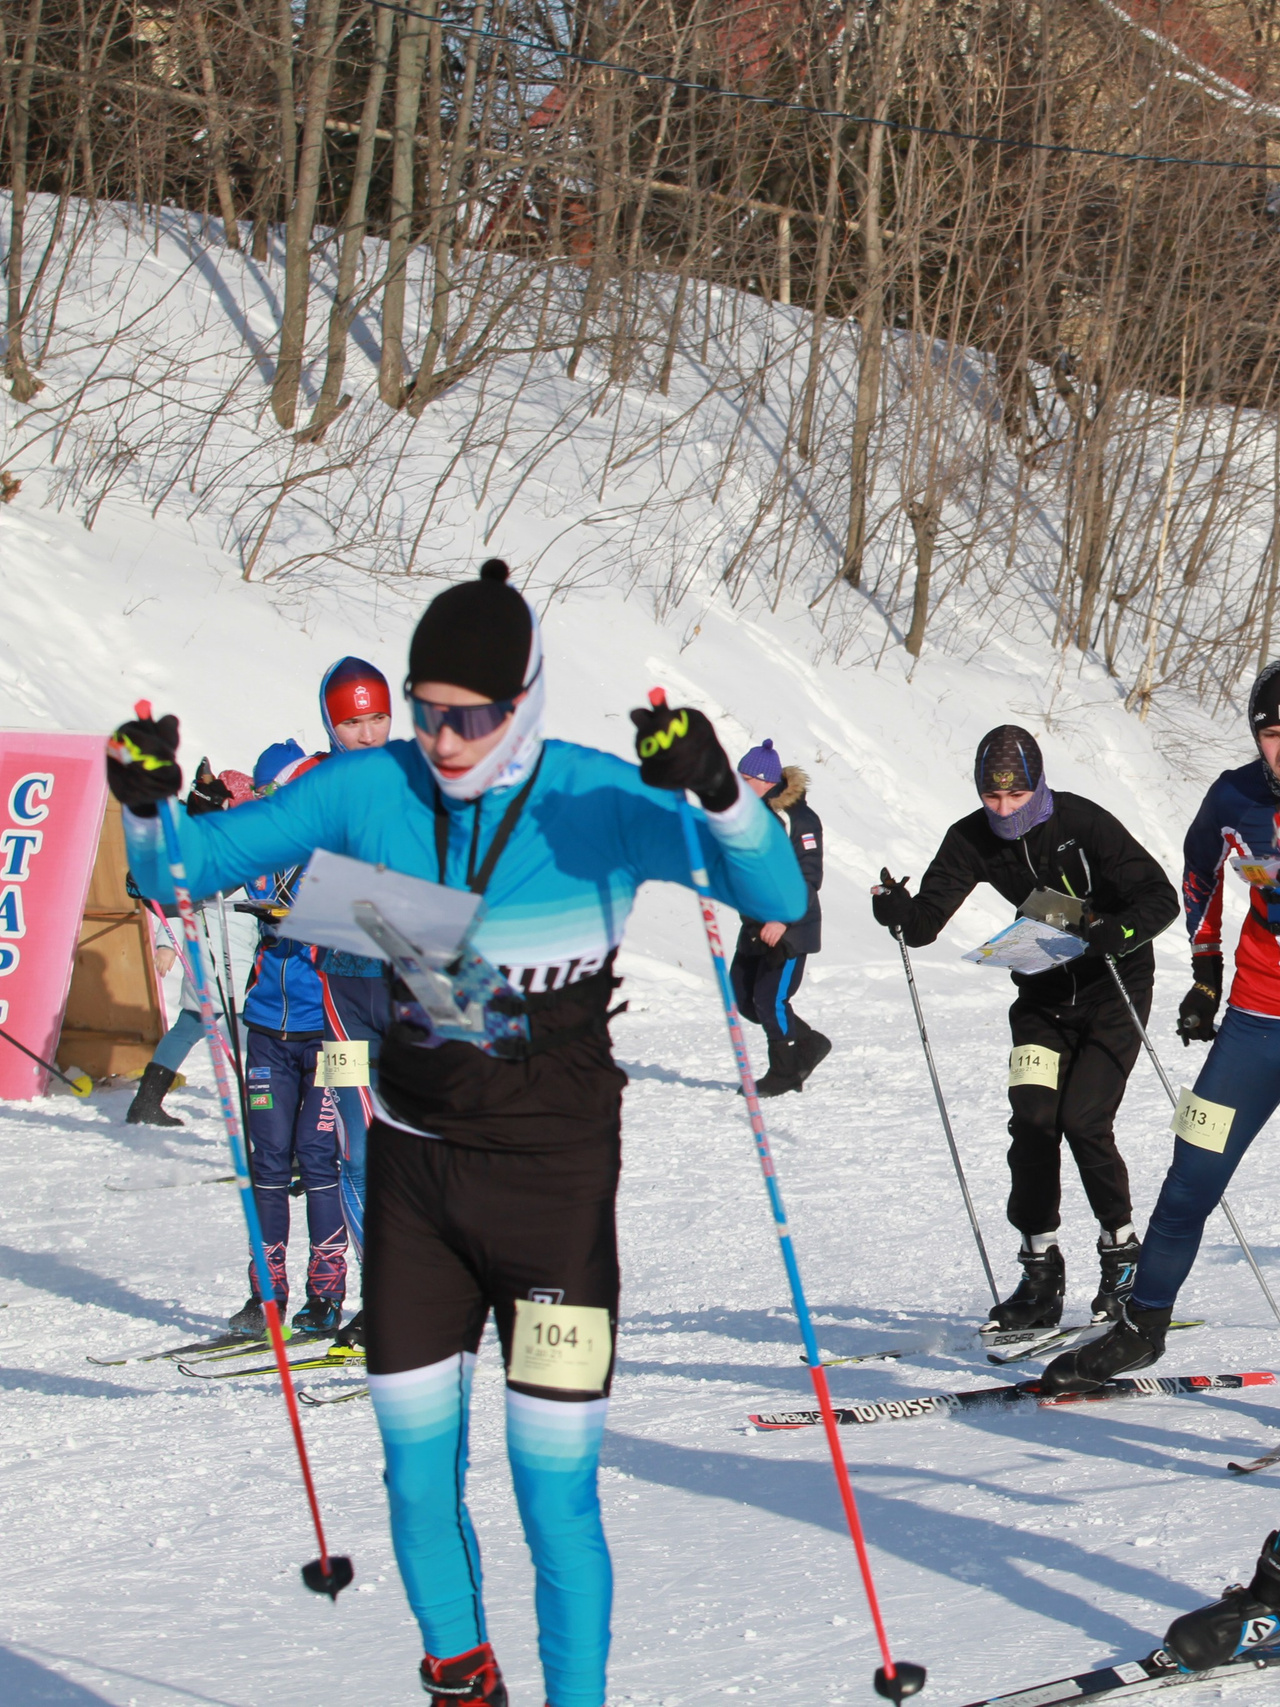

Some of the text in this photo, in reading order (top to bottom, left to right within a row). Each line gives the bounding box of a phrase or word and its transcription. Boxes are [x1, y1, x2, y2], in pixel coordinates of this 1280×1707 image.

[326, 1053, 347, 1066] 115
[1018, 1055, 1041, 1067] 114
[1184, 1105, 1207, 1125] 113
[533, 1321, 578, 1348] 104
[993, 1332, 1035, 1346] FISCHER
